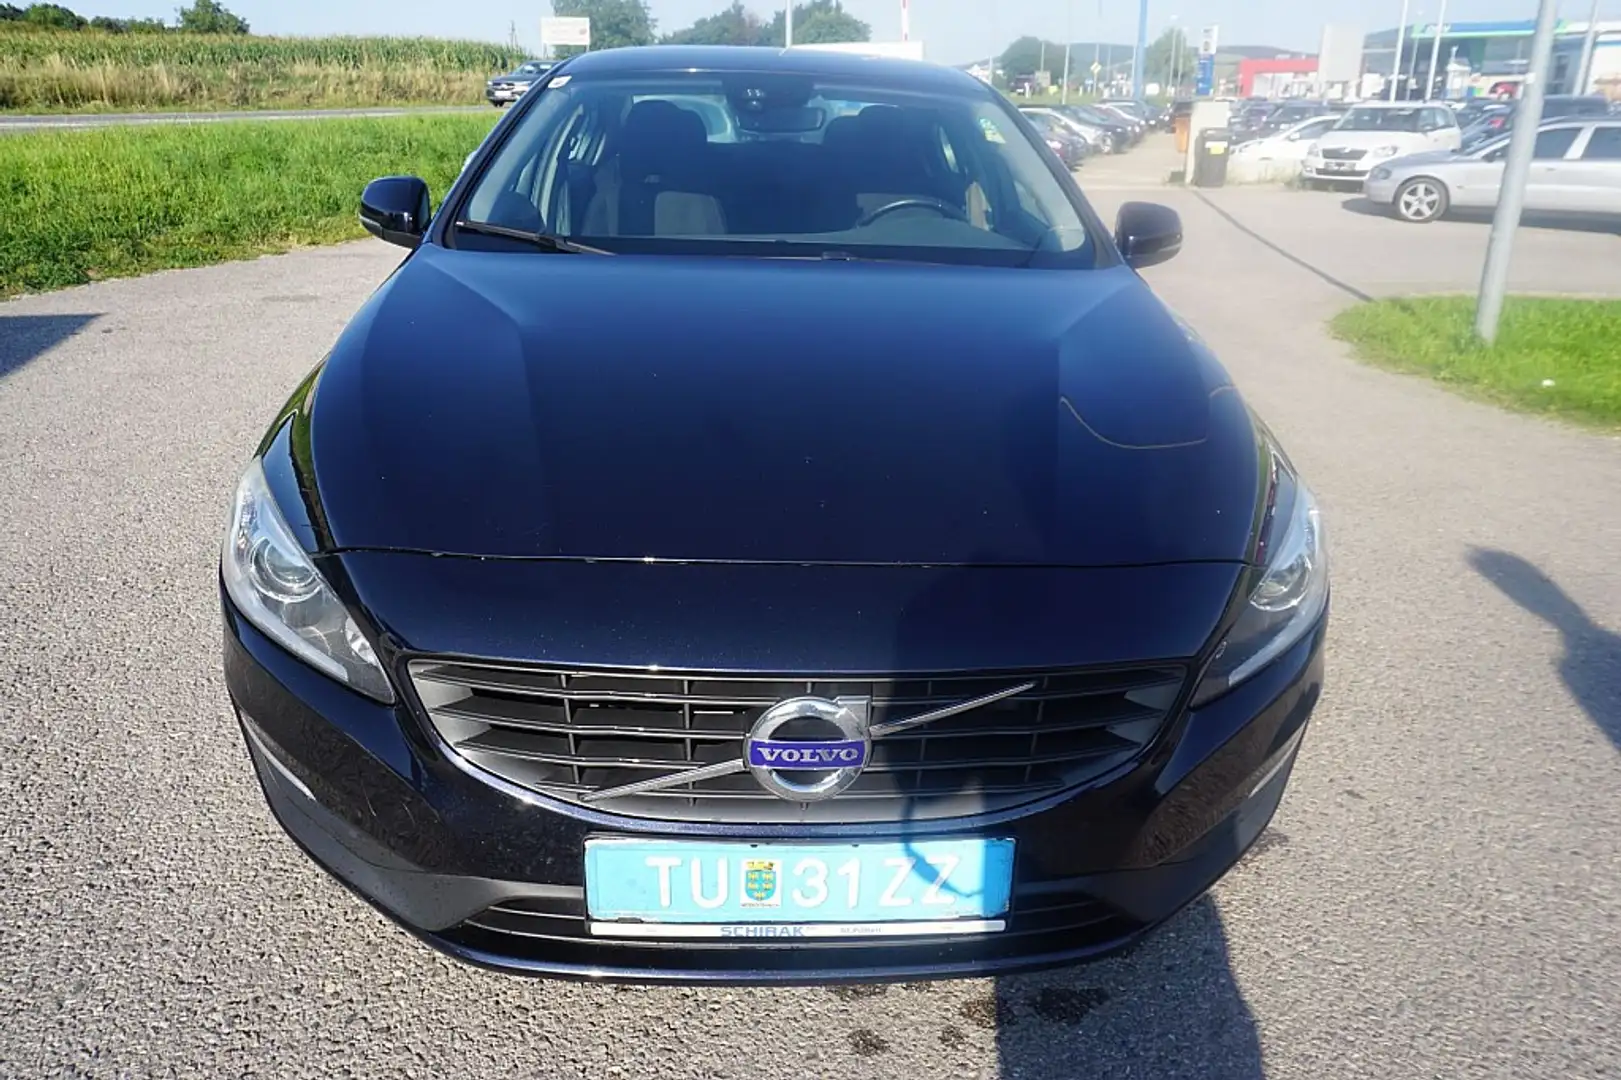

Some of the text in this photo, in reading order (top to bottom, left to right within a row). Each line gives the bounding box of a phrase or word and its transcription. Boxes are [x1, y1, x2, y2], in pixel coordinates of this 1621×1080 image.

[757, 747, 858, 762] VOLVO
[645, 855, 729, 909] TU
[720, 925, 805, 938] SCHIRAK
